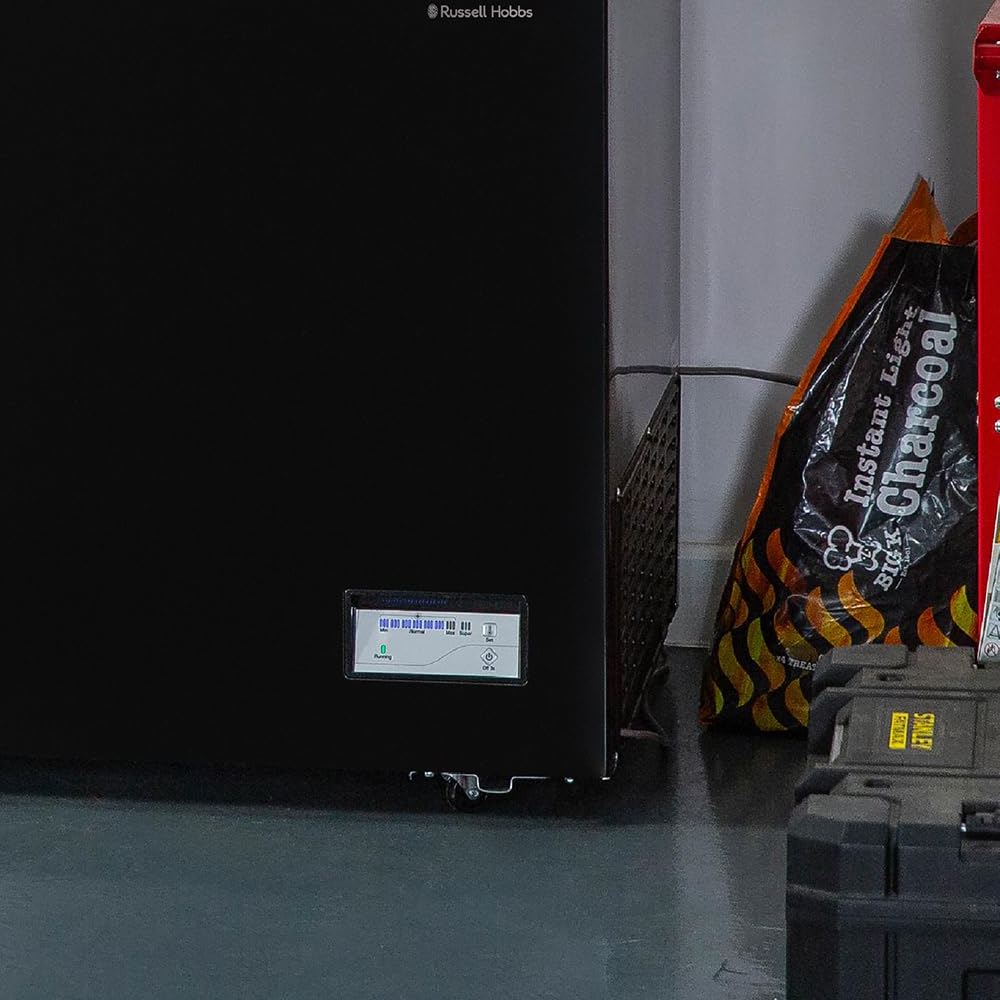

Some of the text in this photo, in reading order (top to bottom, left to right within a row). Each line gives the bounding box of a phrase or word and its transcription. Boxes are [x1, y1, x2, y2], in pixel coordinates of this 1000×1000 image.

[440, 5, 534, 18] Russell Hobbs
[844, 305, 921, 508] Instant Light
[876, 309, 958, 517] Charcoal
[873, 549, 902, 592] BIG
